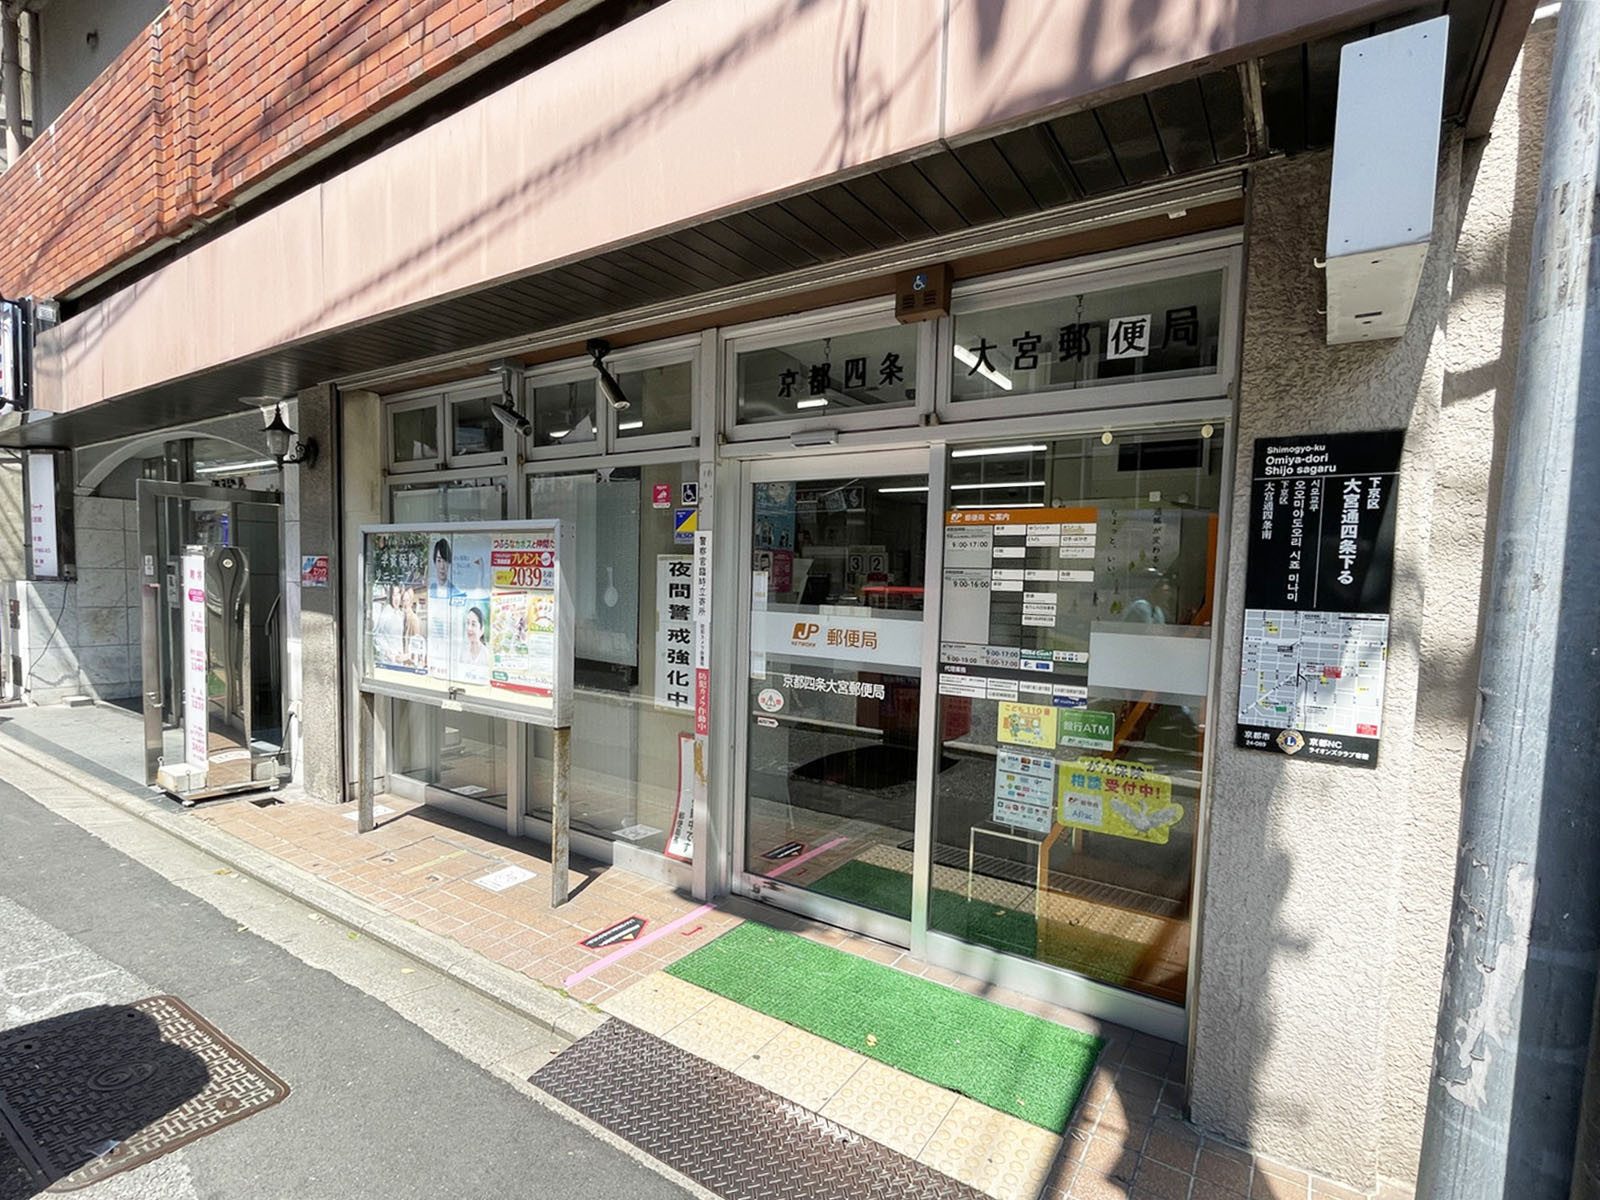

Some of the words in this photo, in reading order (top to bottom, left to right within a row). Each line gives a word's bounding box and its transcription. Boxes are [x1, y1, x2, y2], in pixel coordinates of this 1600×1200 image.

[777, 351, 906, 398] 京都四条
[967, 306, 1201, 377] 大宮郵便局
[1265, 453, 1329, 466] Omiya-dori
[1266, 444, 1326, 455] Shimogyo-ku
[1264, 465, 1294, 476] Shijo
[1296, 464, 1337, 475] sagaru
[1366, 476, 1382, 510] 下京区
[1337, 478, 1363, 585] 大宮通四条下る
[511, 552, 542, 565] プレゼント
[852, 557, 860, 571] 3
[873, 557, 881, 571] 2
[510, 567, 542, 587] 2039
[667, 561, 692, 707] 夜間警戒強化中
[826, 628, 878, 650] 郵便局
[782, 674, 886, 700] 京都四条大宮郵便局
